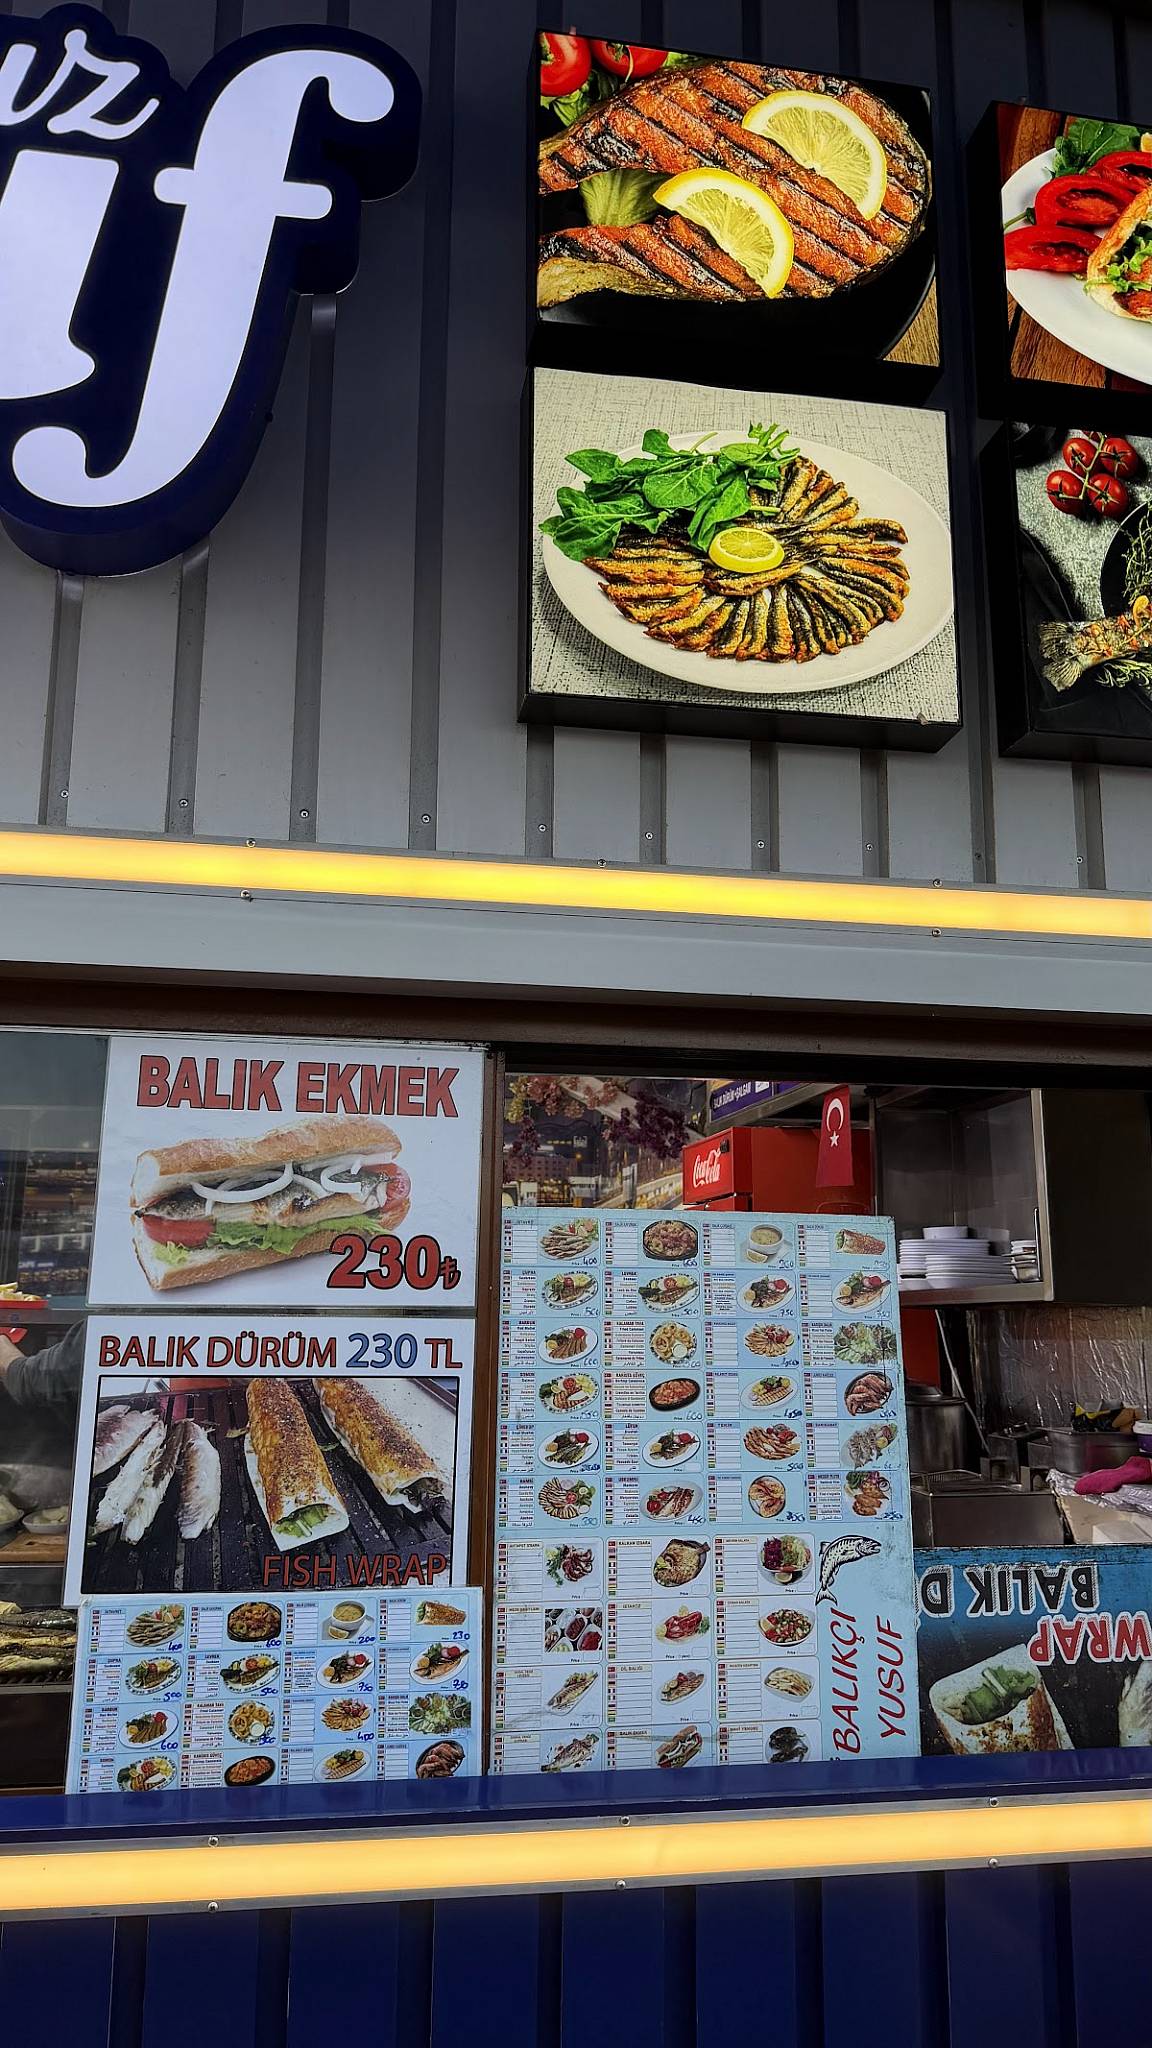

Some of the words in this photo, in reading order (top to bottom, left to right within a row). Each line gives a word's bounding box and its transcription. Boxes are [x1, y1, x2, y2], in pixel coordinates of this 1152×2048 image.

[136, 1054, 285, 1112] BALIK
[296, 1061, 460, 1118] EKMEK
[98, 1335, 201, 1368] BALIK
[206, 1331, 337, 1368] DÜRÜM
[345, 1333, 419, 1369] 230
[424, 1338, 463, 1368] TL
[262, 1554, 337, 1587] FISH
[346, 1553, 448, 1588] WRAP
[966, 1560, 1100, 1616] BALIK
[358, 1636, 376, 1644] 200
[452, 1630, 471, 1640] 230
[1027, 1611, 1152, 1665] WRAP
[830, 1606, 865, 1754] BALIKÇI
[876, 1614, 907, 1739] YUSUF
[163, 1691, 182, 1702] 500
[160, 1739, 179, 1751] 600
